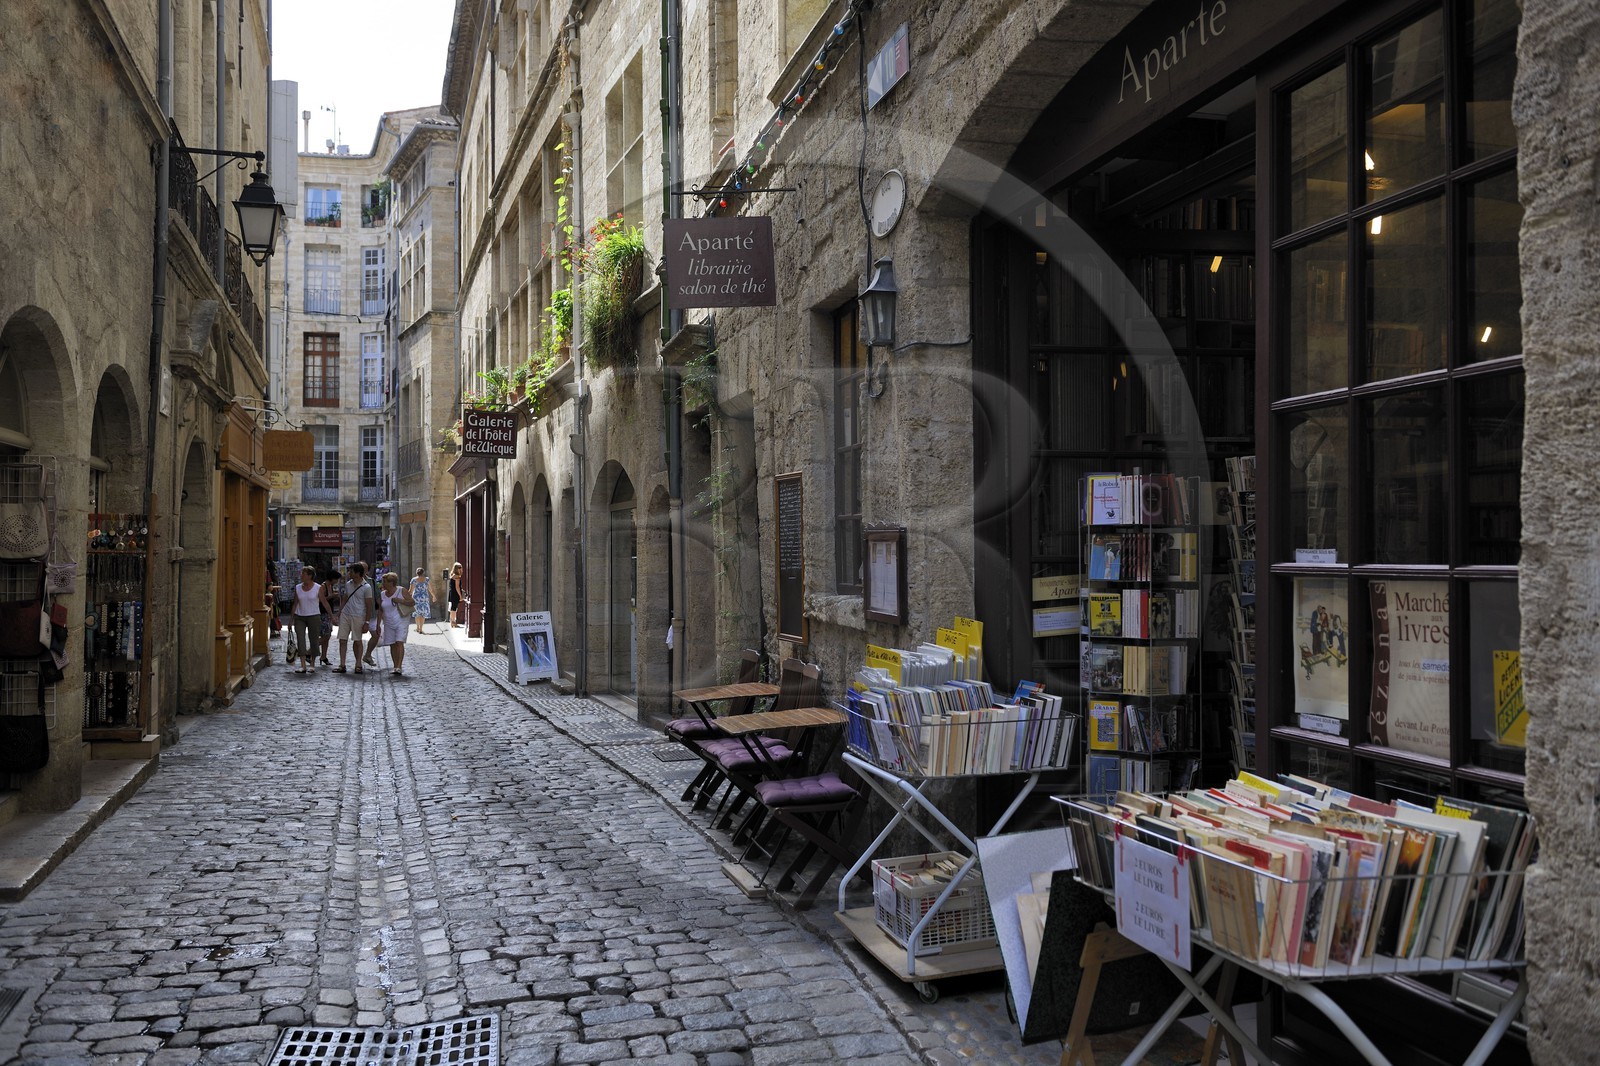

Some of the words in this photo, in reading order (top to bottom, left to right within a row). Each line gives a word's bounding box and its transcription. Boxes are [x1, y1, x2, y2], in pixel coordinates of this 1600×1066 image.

[678, 230, 754, 255] Aparté
[688, 258, 752, 275] librairie
[679, 278, 716, 295] salon
[720, 278, 738, 294] de
[742, 277, 767, 293] thé
[467, 414, 514, 428] Galerie
[466, 429, 477, 440] de
[1394, 591, 1450, 613] Marché
[1398, 615, 1450, 644] livres
[1394, 718, 1418, 731] devant
[1419, 721, 1429, 732] La
[1134, 857, 1139, 868] 2
[1138, 858, 1163, 878] EUROS
[1133, 871, 1142, 885] LE
[1143, 873, 1166, 894] LIVRE
[1135, 901, 1140, 912] 2
[1141, 904, 1164, 923] EUROS
[1134, 915, 1143, 929] LE
[1144, 917, 1167, 940] LIVRE
